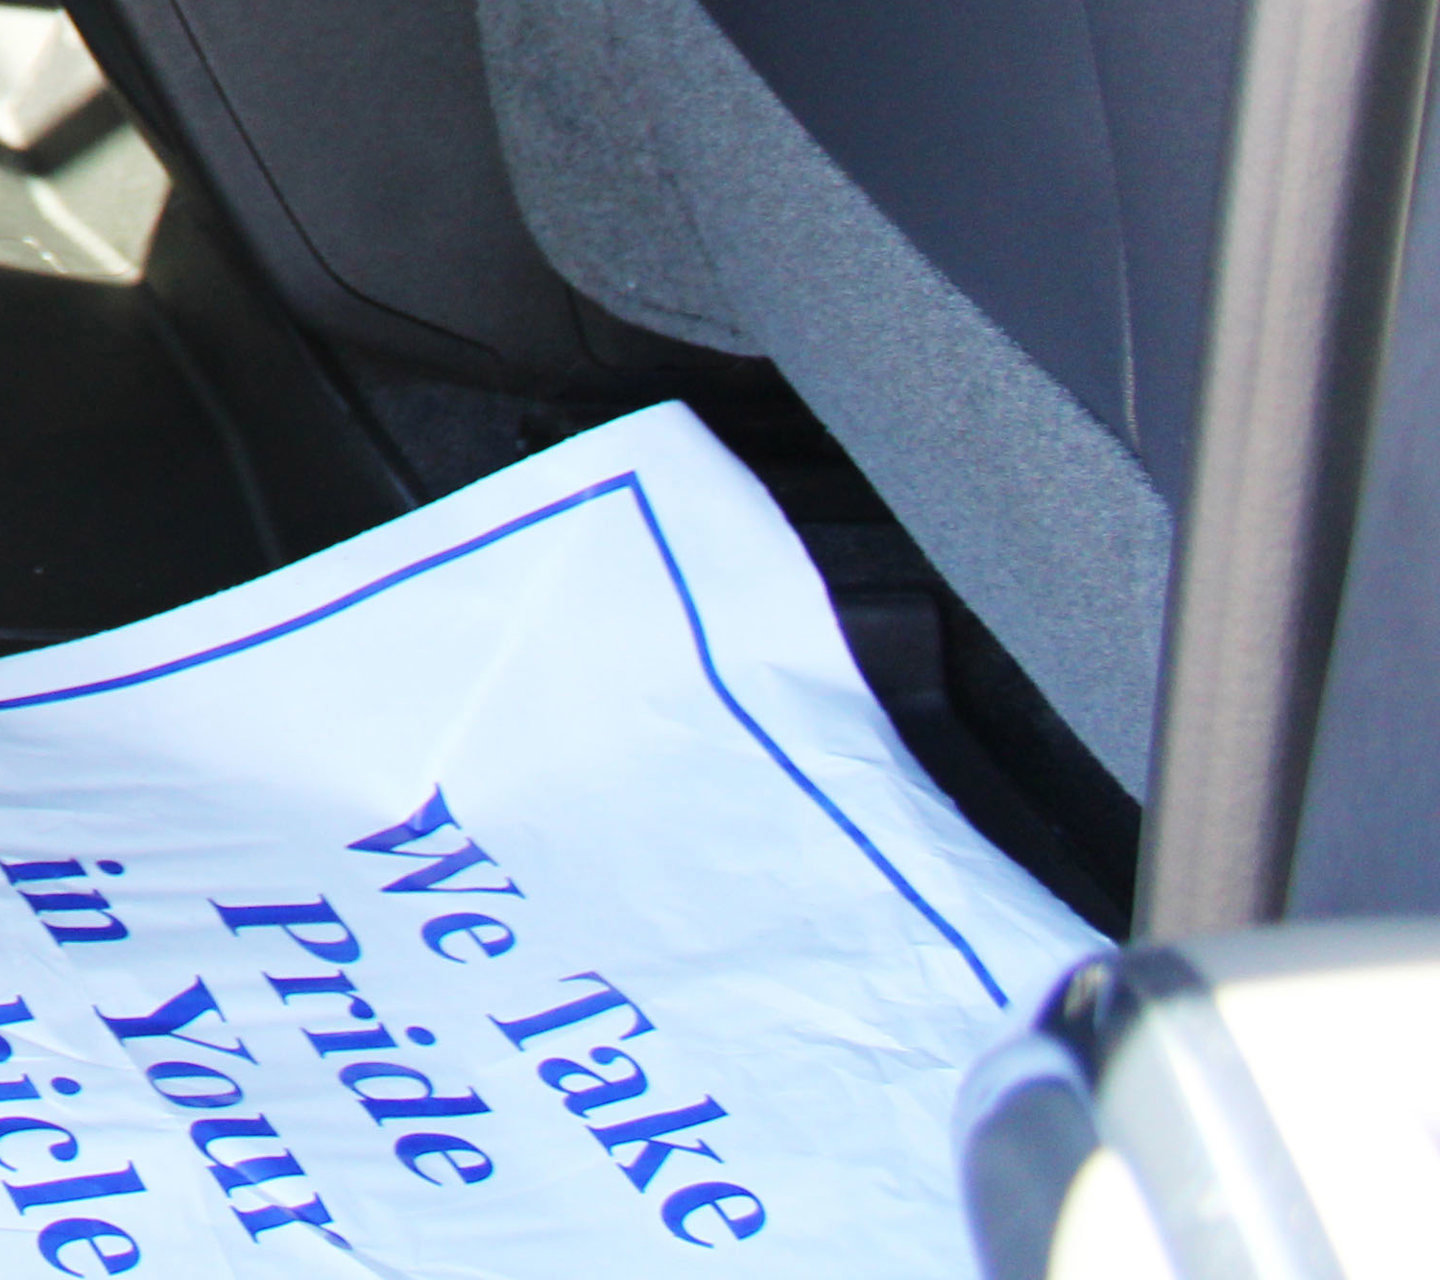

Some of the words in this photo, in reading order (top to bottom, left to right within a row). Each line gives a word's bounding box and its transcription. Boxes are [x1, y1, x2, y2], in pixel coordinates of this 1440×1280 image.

[92, 974, 353, 1251] Your
[207, 893, 496, 1187] Pride
[345, 782, 527, 964] We
[486, 970, 768, 1249] Take
